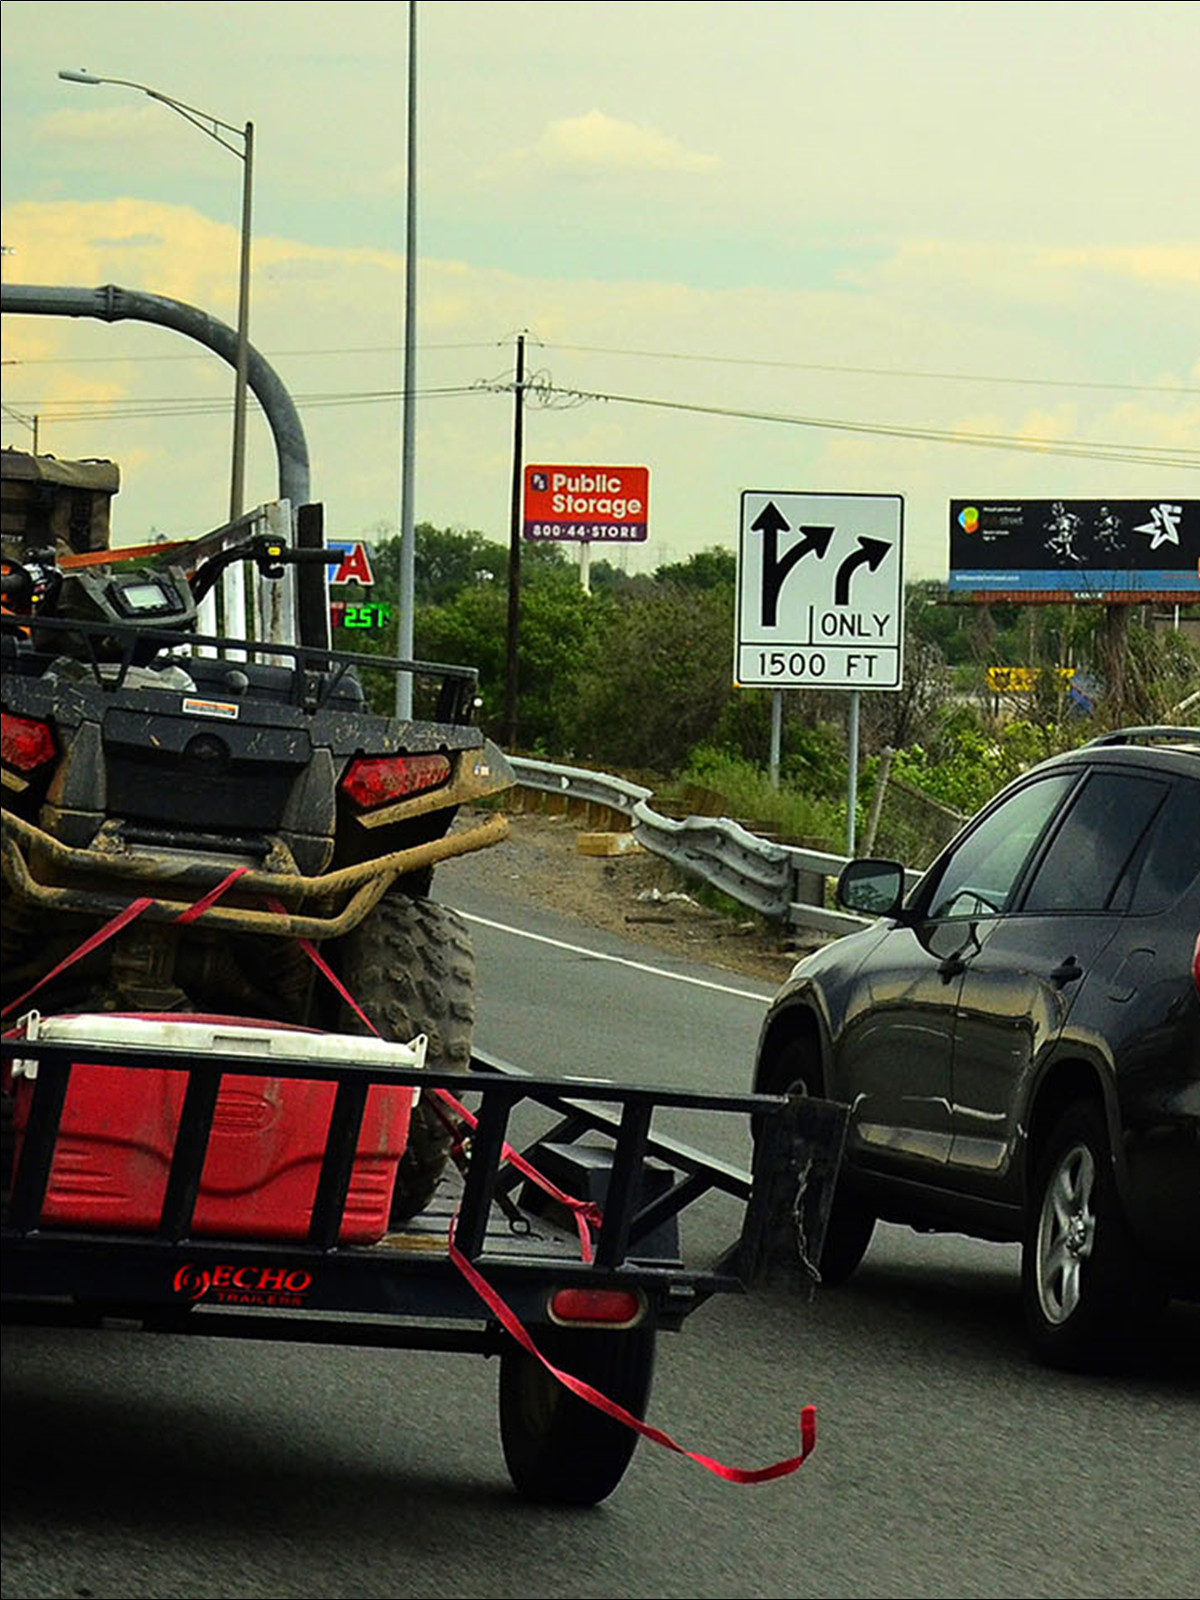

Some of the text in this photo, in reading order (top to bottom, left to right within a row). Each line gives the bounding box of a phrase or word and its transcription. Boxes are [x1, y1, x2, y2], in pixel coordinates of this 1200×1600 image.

[553, 473, 622, 493] Public
[552, 494, 642, 519] Storage
[821, 612, 890, 637] ONLY
[760, 653, 878, 678] 1500 FT
[212, 1265, 311, 1291] ECHO
